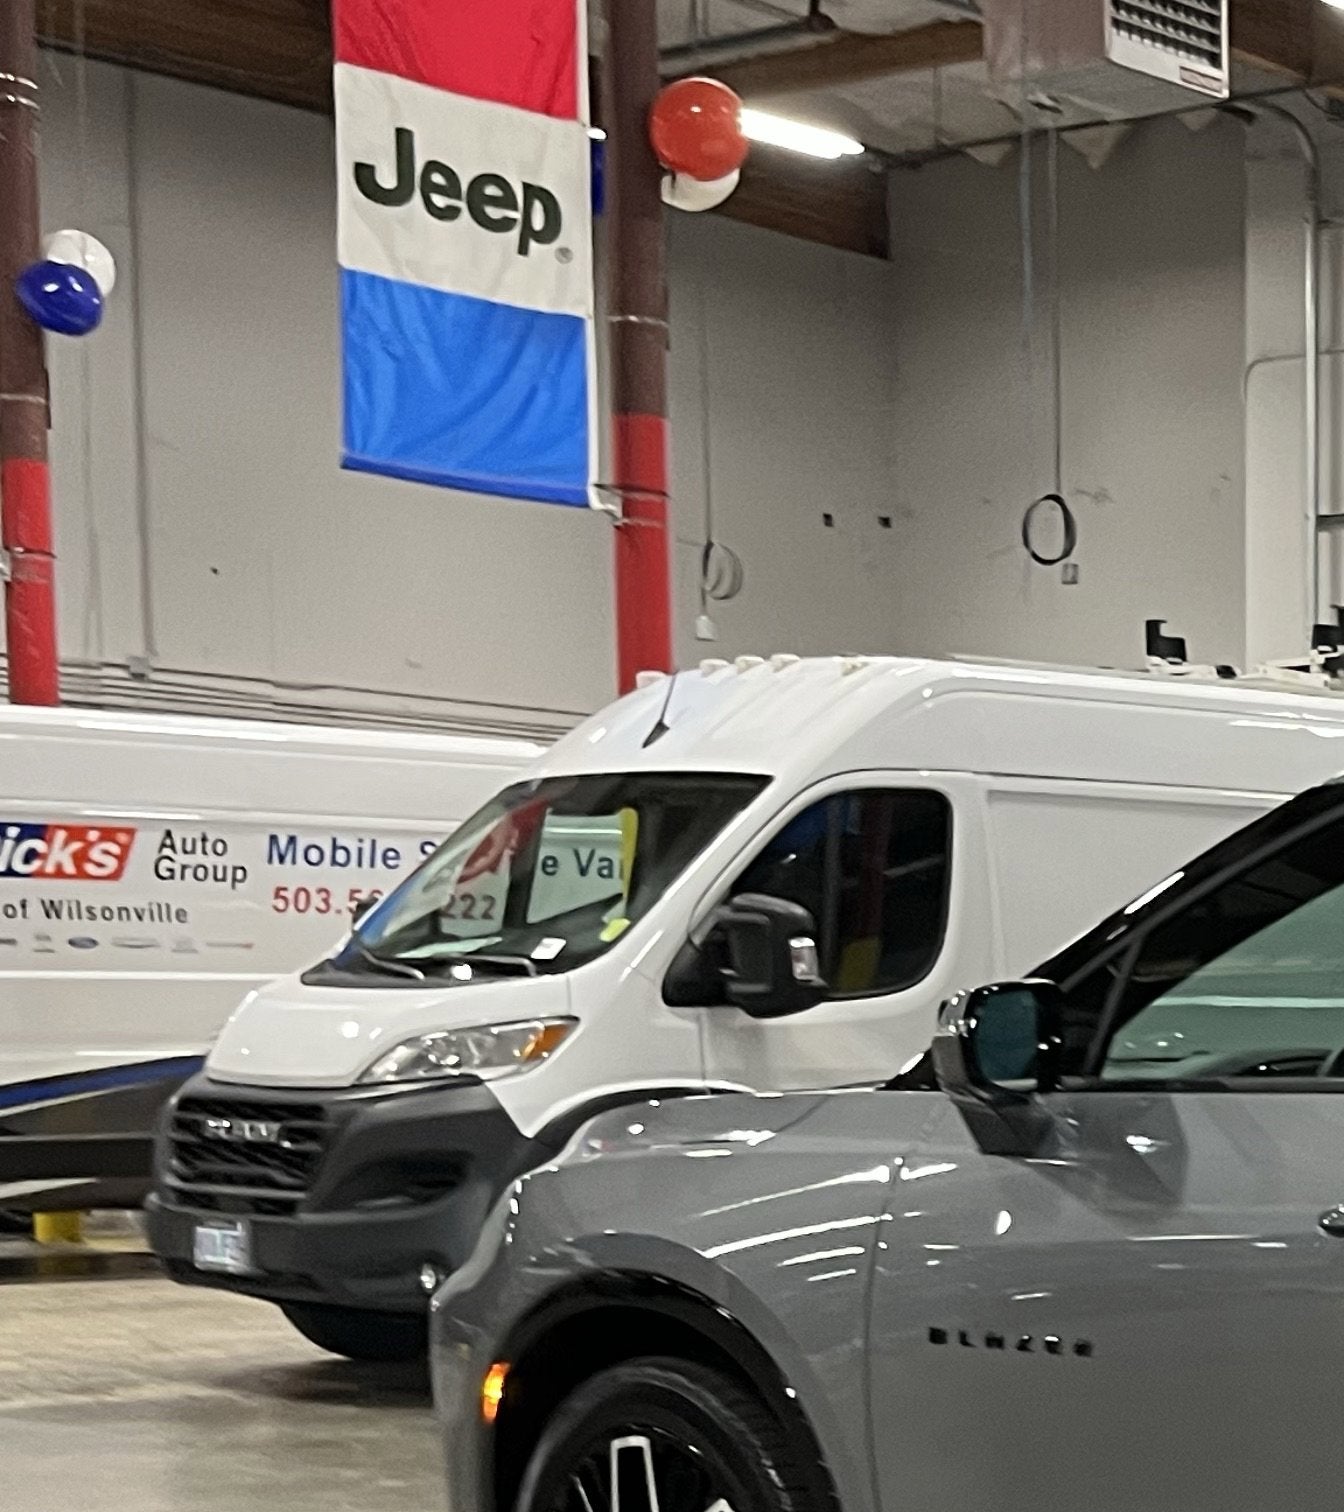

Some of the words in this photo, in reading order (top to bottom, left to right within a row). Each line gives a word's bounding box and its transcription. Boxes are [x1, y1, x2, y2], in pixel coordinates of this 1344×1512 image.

[354, 127, 562, 257] Jeep
[0, 826, 121, 876] ick's
[157, 829, 228, 857] Auto
[267, 834, 400, 869] Mobile
[154, 855, 248, 890] Group
[3, 898, 28, 919] of
[41, 899, 188, 923] Wilsonville
